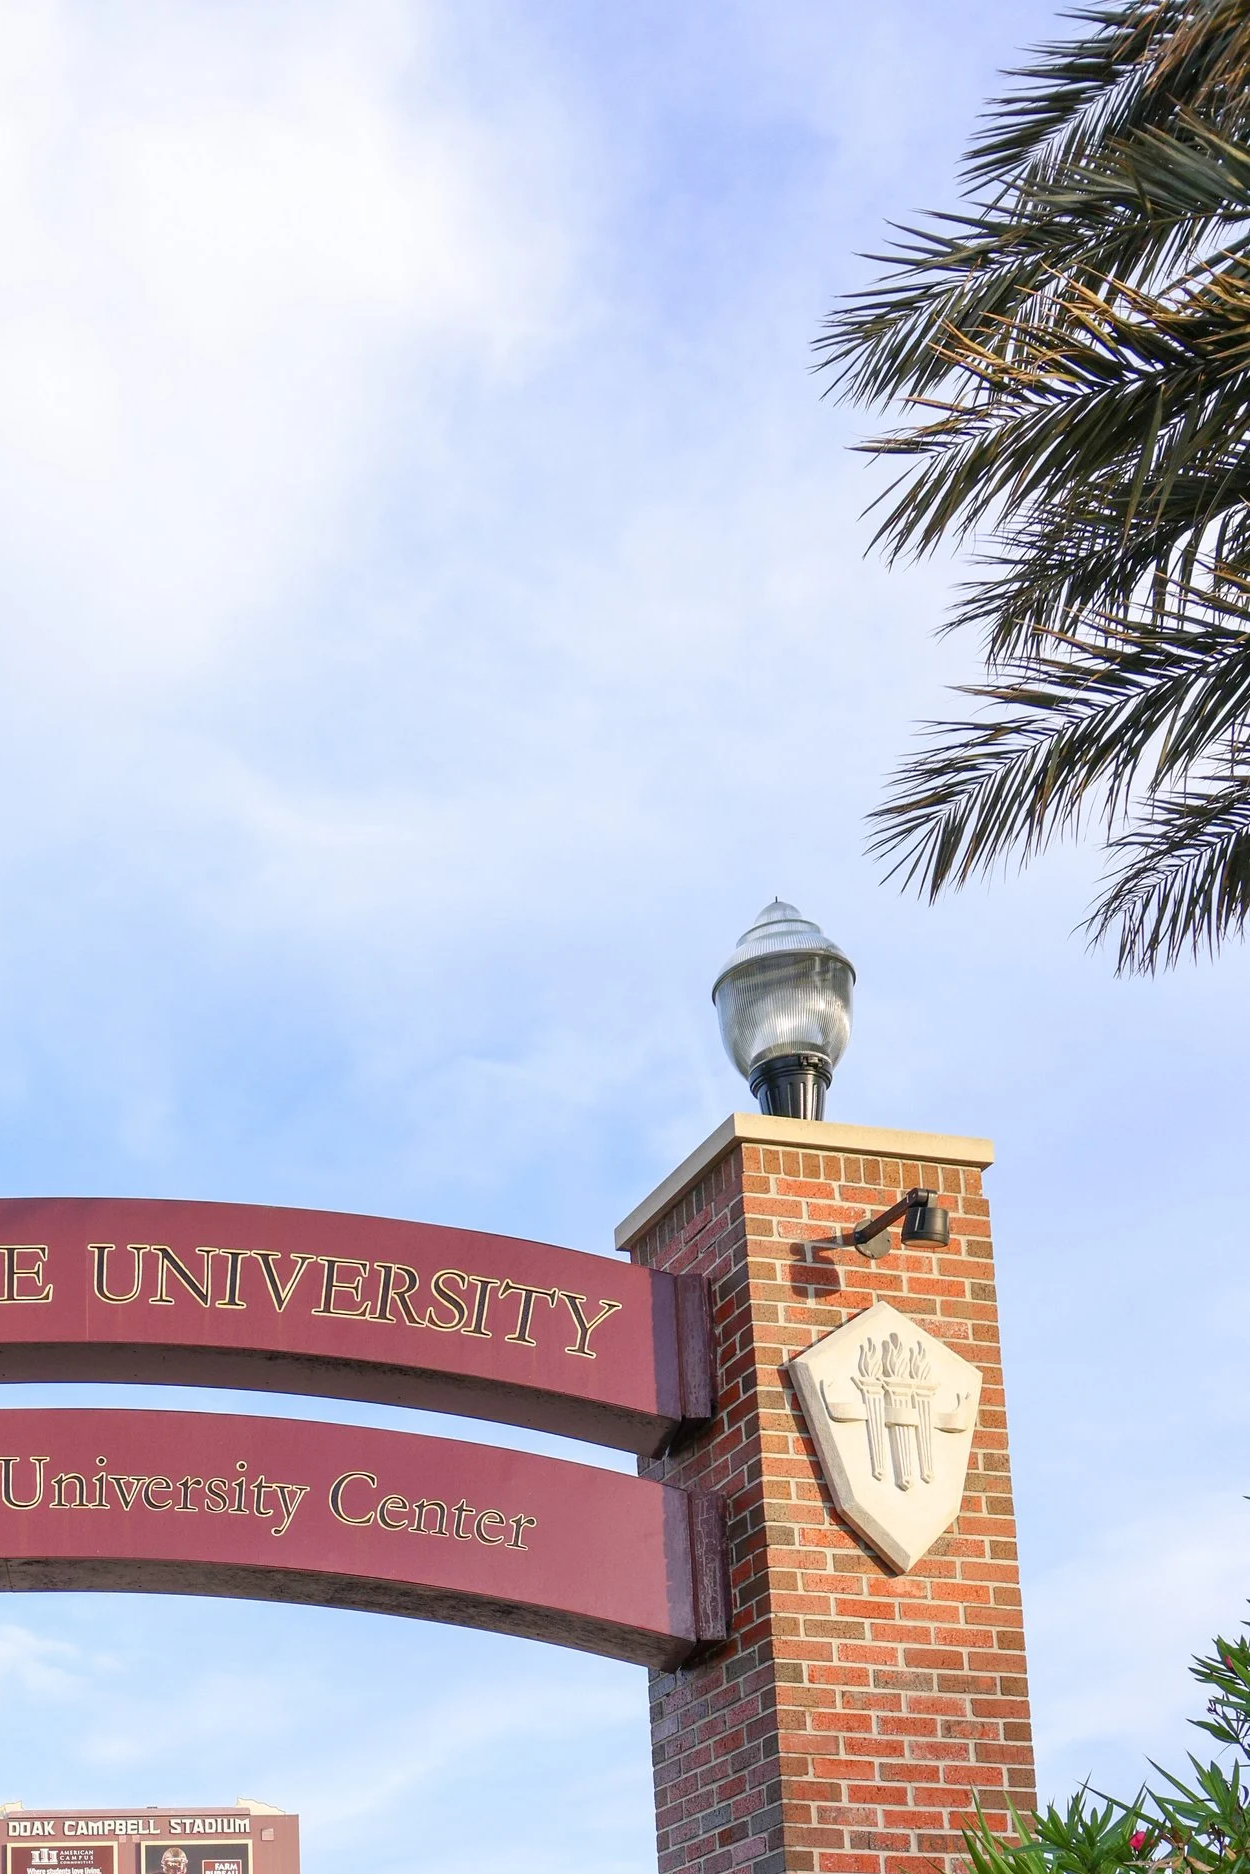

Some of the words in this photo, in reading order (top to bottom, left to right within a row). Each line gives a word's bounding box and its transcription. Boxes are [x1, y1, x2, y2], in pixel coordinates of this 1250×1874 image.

[87, 1243, 623, 1359] UNIVERSITY
[328, 1471, 537, 1552] Center
[7, 1821, 55, 1837] DOAK
[63, 1819, 161, 1836] CAMPBELL
[168, 1817, 251, 1835] STADIUM
[71, 1867, 84, 1874] love
[214, 1862, 238, 1871] FARM
